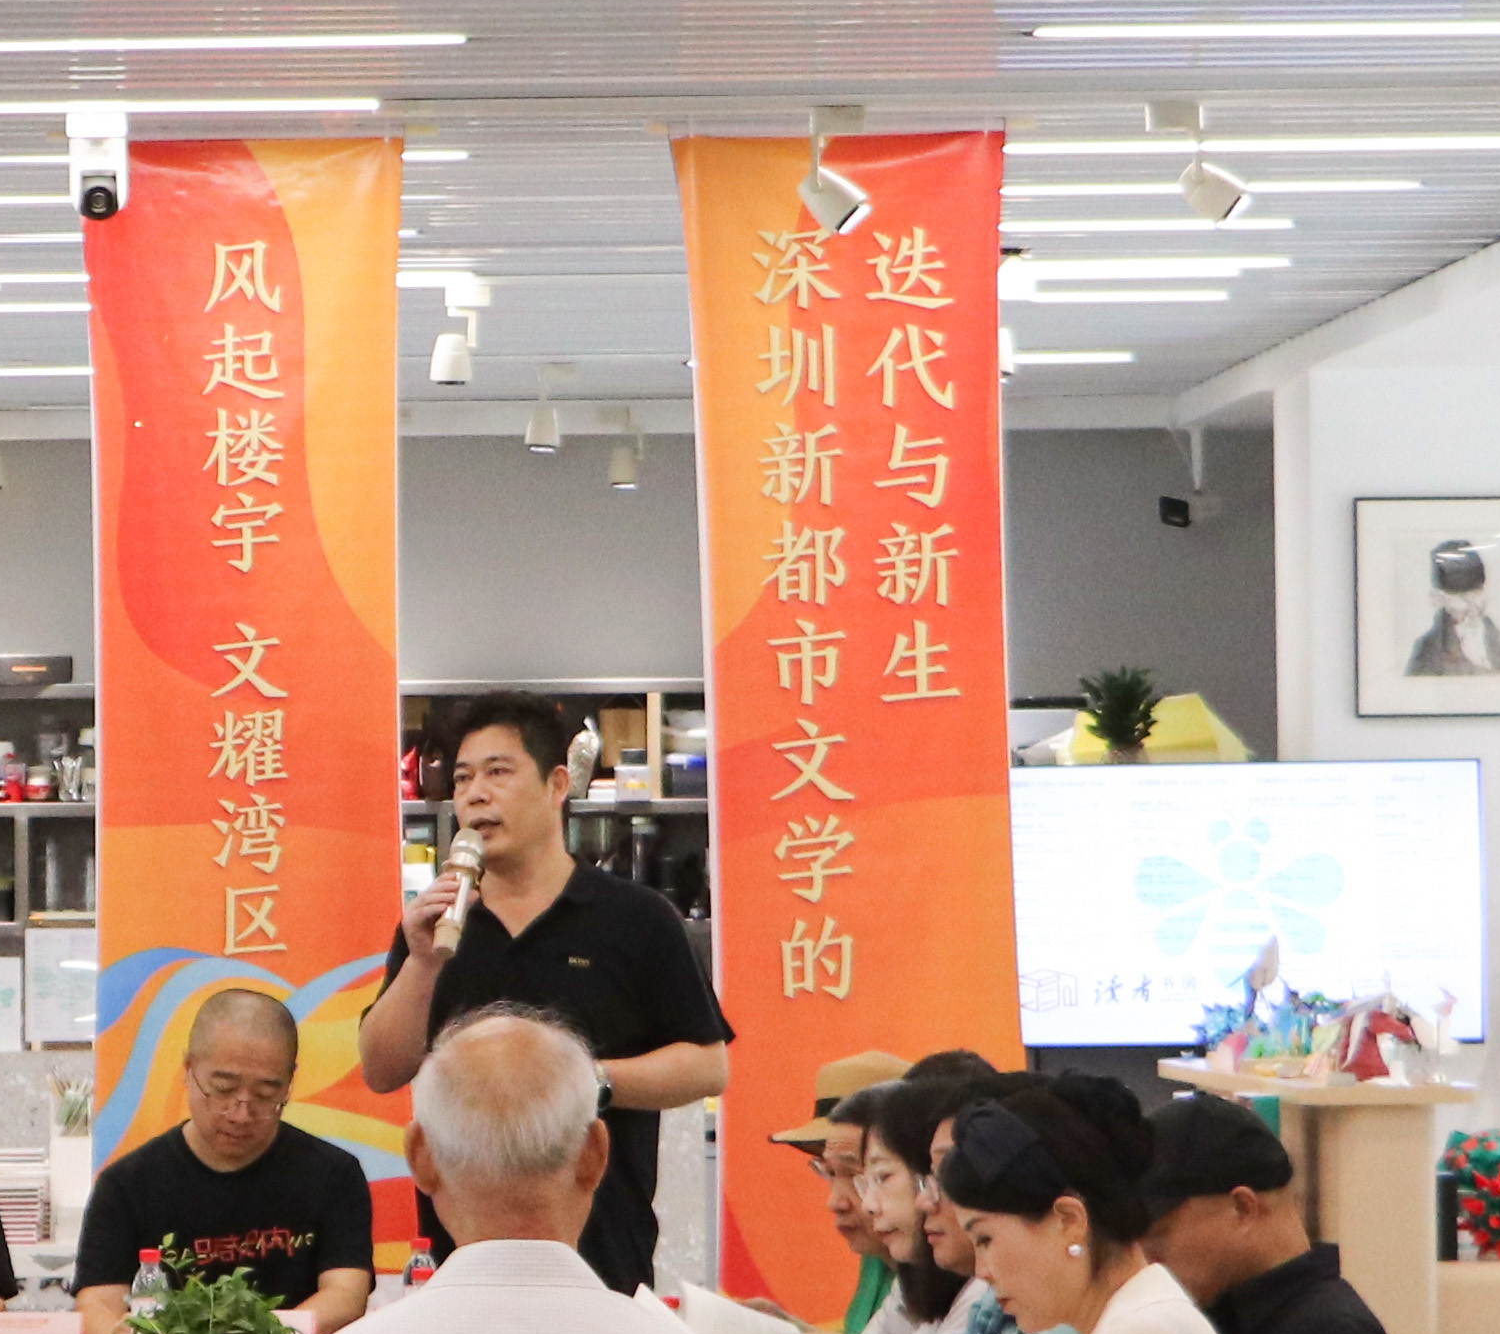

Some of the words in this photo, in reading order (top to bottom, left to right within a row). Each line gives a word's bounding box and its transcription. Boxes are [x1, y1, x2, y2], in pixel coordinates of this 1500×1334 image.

[202, 239, 286, 574] 风起楼宇
[865, 225, 961, 704] 迭代与新生
[208, 621, 288, 957] 文耀湾区
[751, 228, 855, 1001] 深圳新都市文学的
